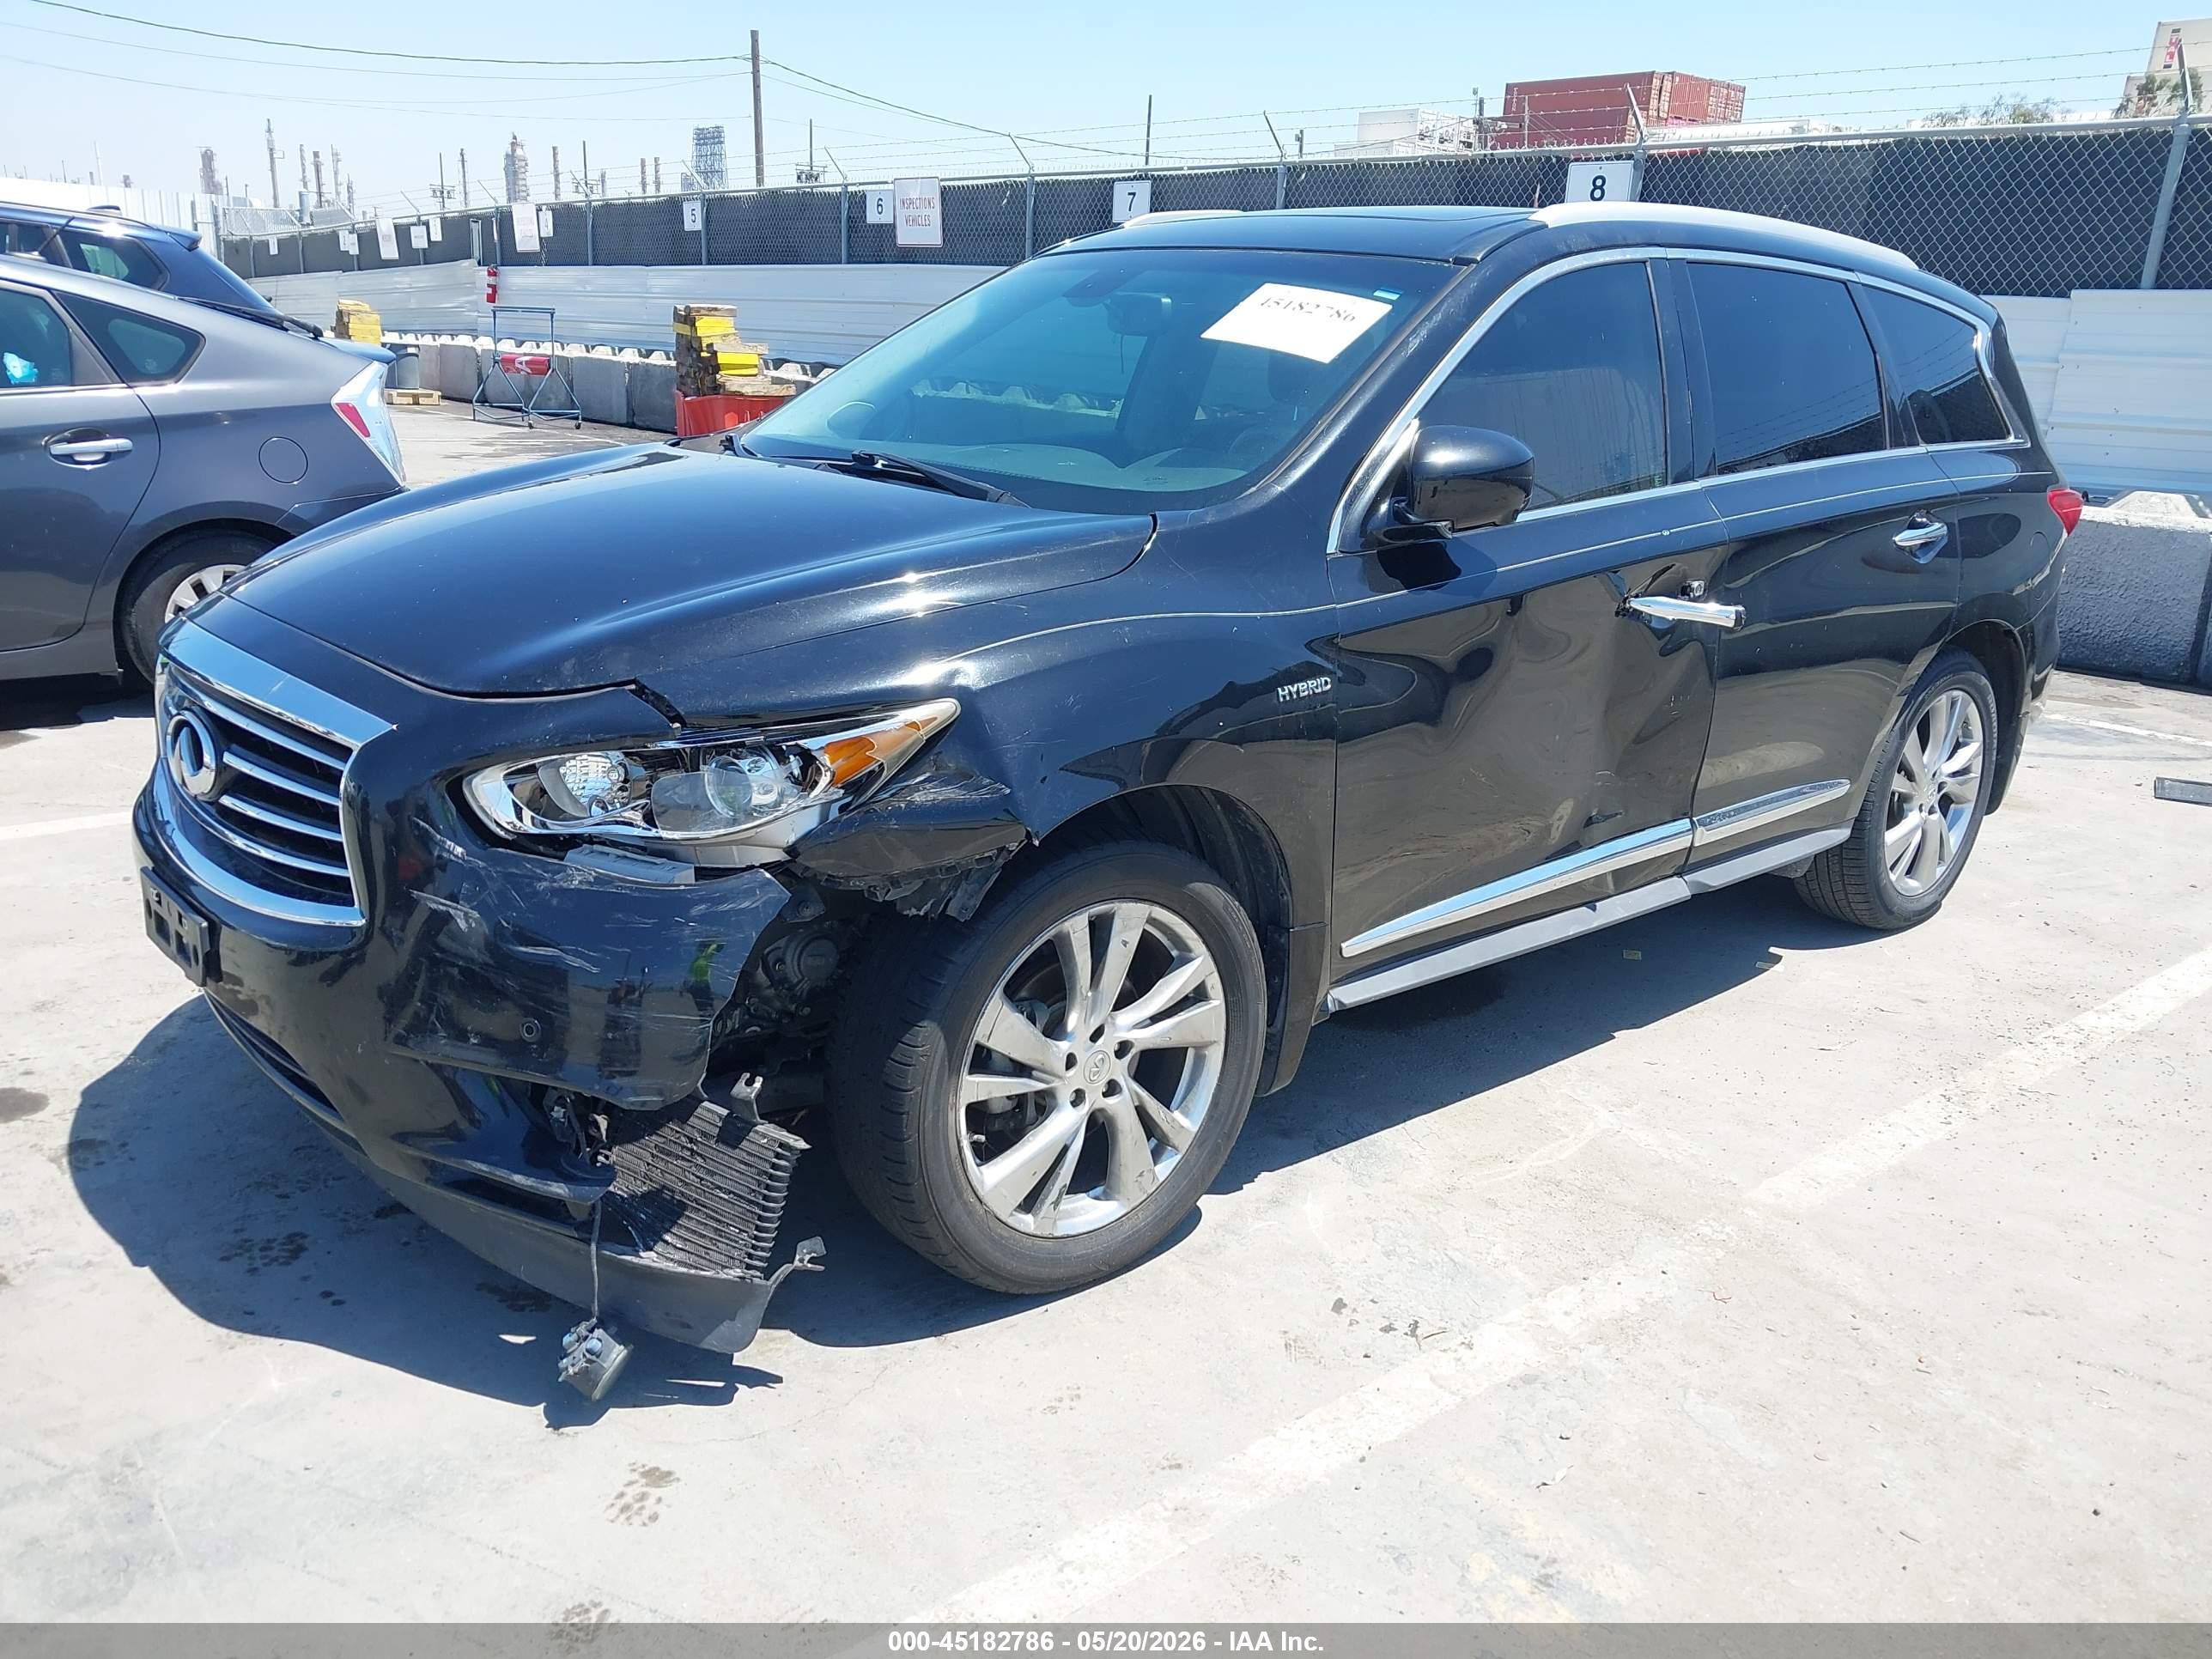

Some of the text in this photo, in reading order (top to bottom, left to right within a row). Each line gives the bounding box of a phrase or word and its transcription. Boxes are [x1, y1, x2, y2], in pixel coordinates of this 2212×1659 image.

[1590, 174, 1607, 202] 8
[877, 198, 884, 215] 6
[899, 197, 935, 210] INSPECTIONS
[1127, 191, 1136, 212] 7
[690, 208, 696, 223] 5
[904, 214, 931, 228] VEHICLES
[1277, 677, 1333, 702] HYBRID
